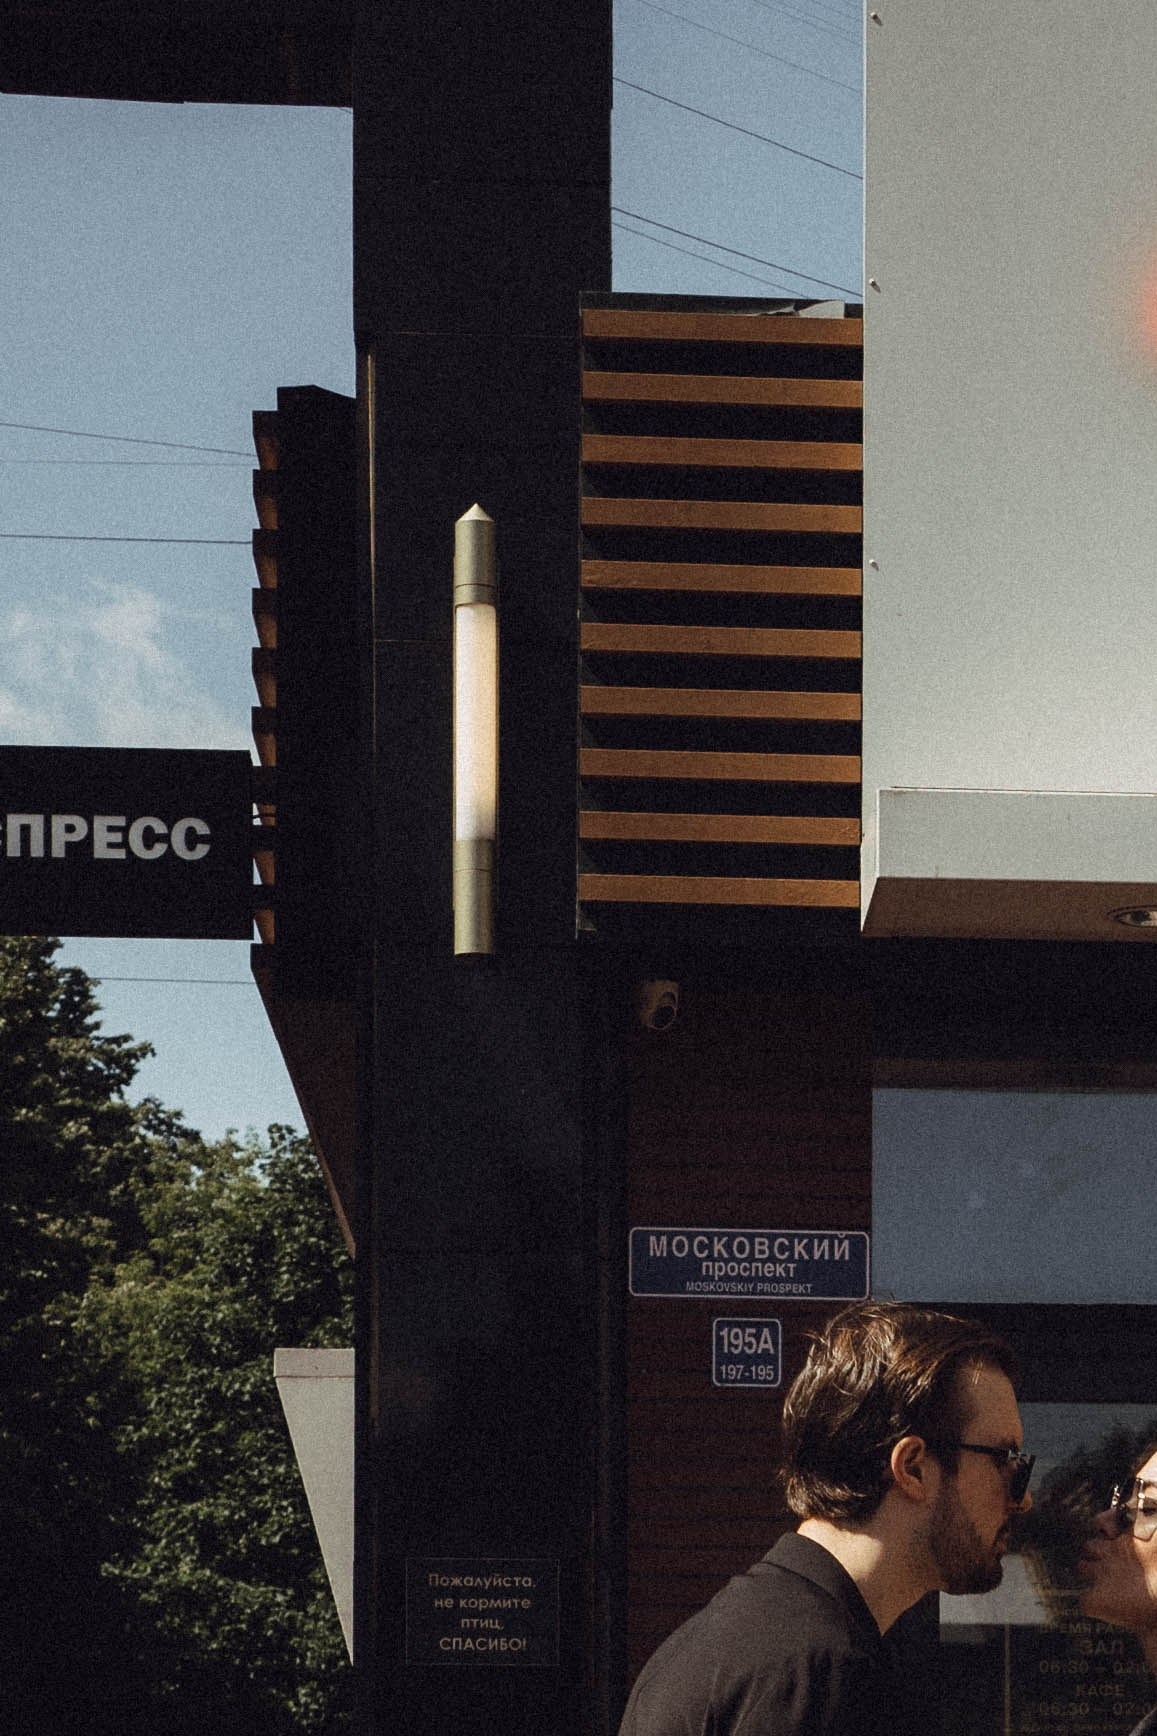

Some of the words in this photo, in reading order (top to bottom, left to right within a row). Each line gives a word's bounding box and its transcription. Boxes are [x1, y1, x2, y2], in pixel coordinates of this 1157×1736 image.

[0, 813, 211, 861] ПРЕСС
[649, 1232, 851, 1261] МОСКОВСКИЙ
[701, 1261, 798, 1280] проспект
[686, 1281, 754, 1293] MOSKOVSKIY
[757, 1282, 813, 1294] PROSPEKT
[719, 1326, 775, 1355] 195А
[720, 1364, 774, 1381] 197-195
[433, 1598, 455, 1609] не
[459, 1598, 532, 1611] кормите
[439, 1637, 527, 1651] СПАСИБО!
[1080, 1639, 1125, 1655] ЗАЛ
[1112, 1660, 1152, 1674] 02:0
[1075, 1684, 1126, 1697] КАФЕ
[1112, 1702, 1152, 1715] 02:0
